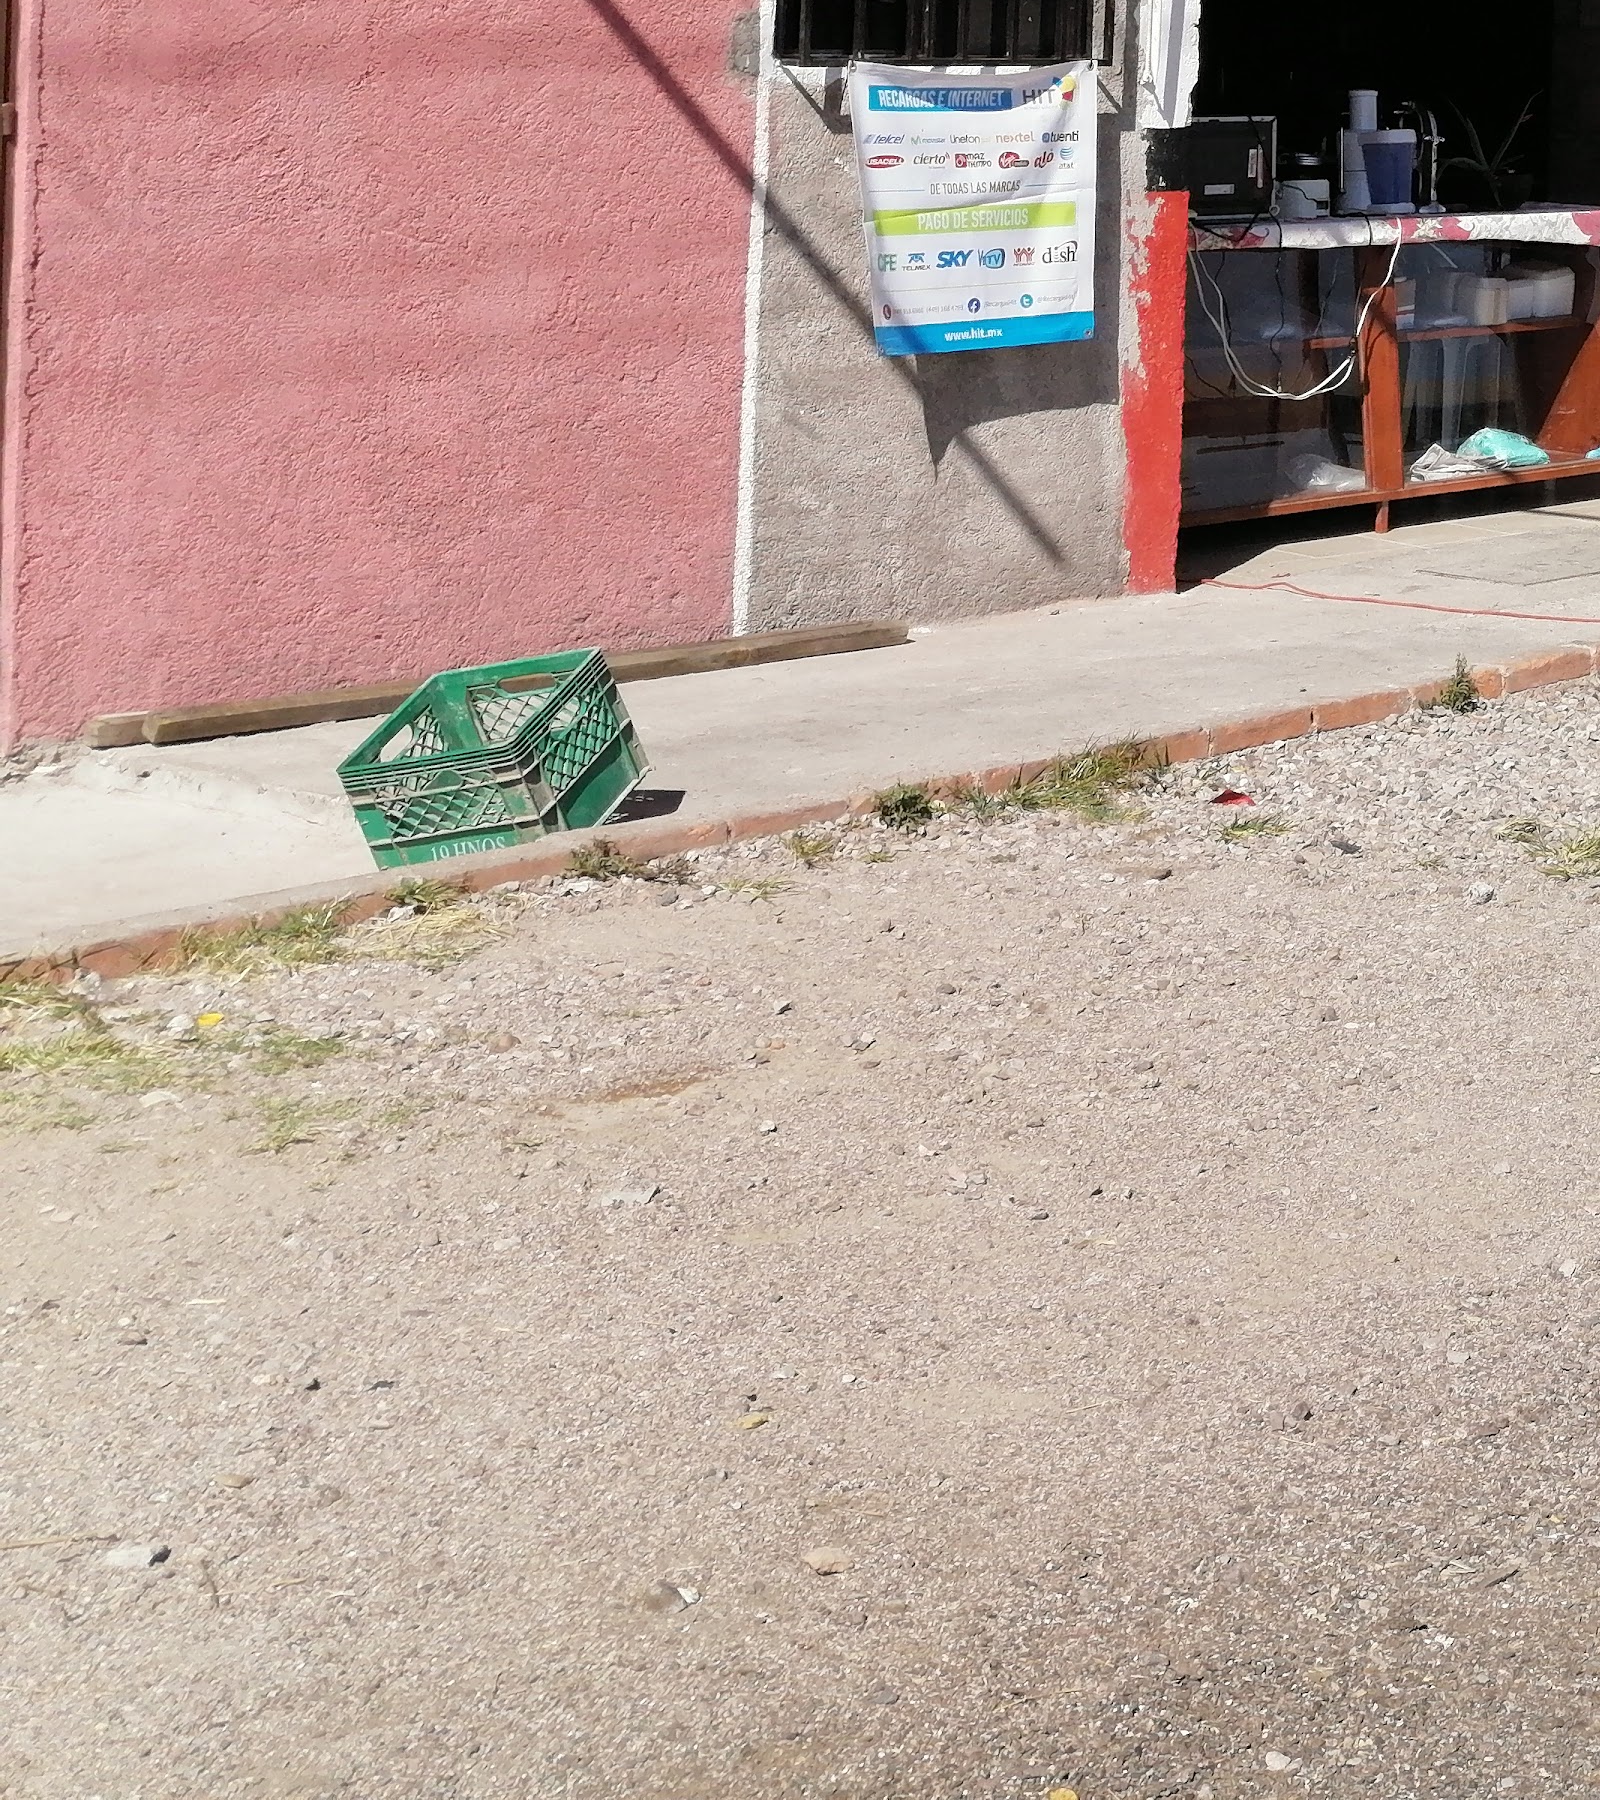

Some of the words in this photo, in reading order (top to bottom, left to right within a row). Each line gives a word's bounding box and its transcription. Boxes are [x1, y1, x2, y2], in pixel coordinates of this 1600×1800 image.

[877, 88, 936, 108] RECARGAS
[937, 89, 946, 107] E
[946, 88, 1005, 108] INTERNET
[1022, 88, 1057, 105] HIT
[873, 132, 906, 145] telcel
[995, 130, 1036, 144] nextel
[912, 151, 946, 165] cierto
[930, 182, 941, 195] DE
[942, 182, 969, 195] TODAS
[970, 181, 987, 194] LAS
[989, 179, 1021, 194] MARCAS
[917, 213, 950, 231] PAGO
[953, 211, 968, 229] DE
[970, 207, 1029, 228] SERVICIOS
[877, 252, 897, 272] CFE
[935, 248, 974, 269] SKY
[1041, 240, 1079, 265] dish
[943, 327, 1003, 342] www.hit.mx
